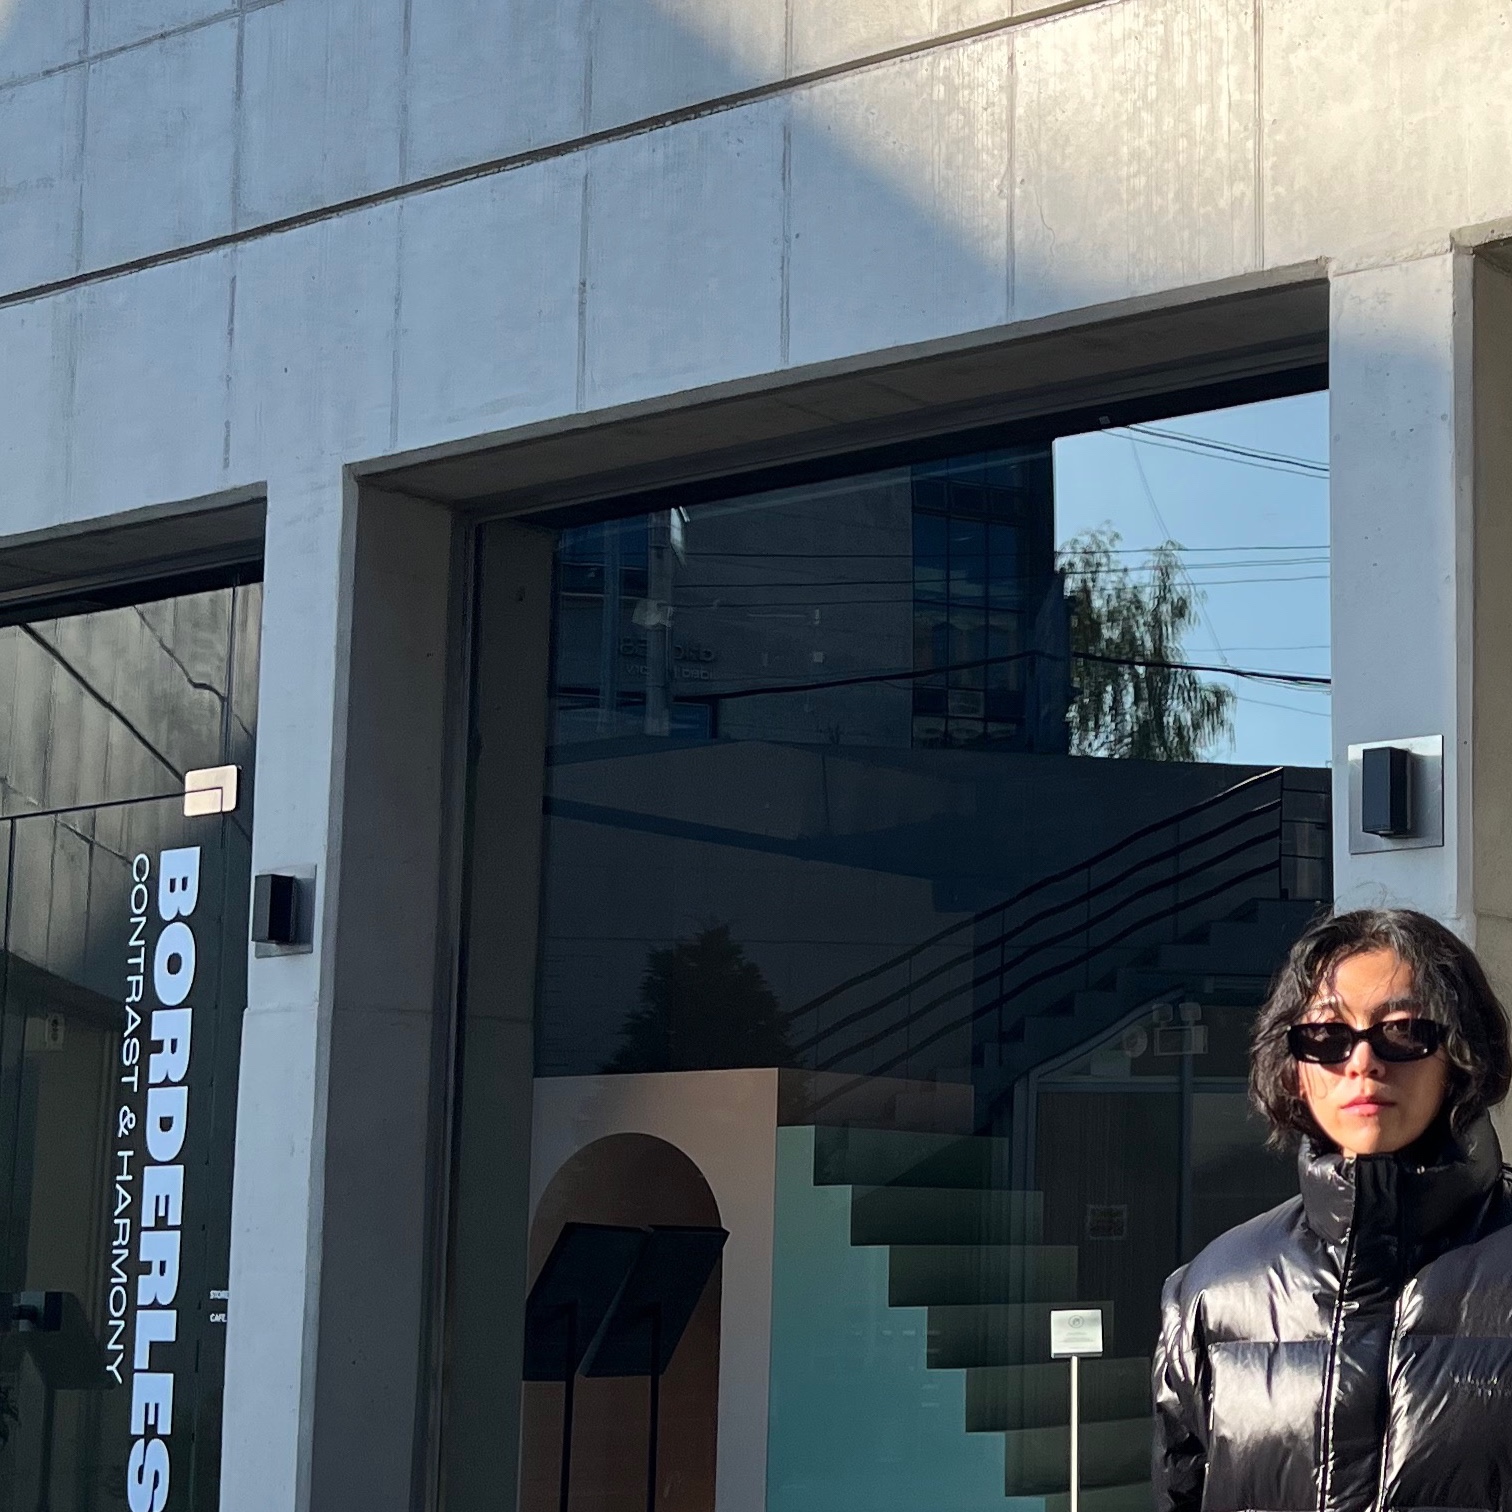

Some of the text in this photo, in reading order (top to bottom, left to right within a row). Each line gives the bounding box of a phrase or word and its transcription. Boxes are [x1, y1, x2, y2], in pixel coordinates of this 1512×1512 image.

[105, 853, 150, 1384] CONTRAST & HARMONY
